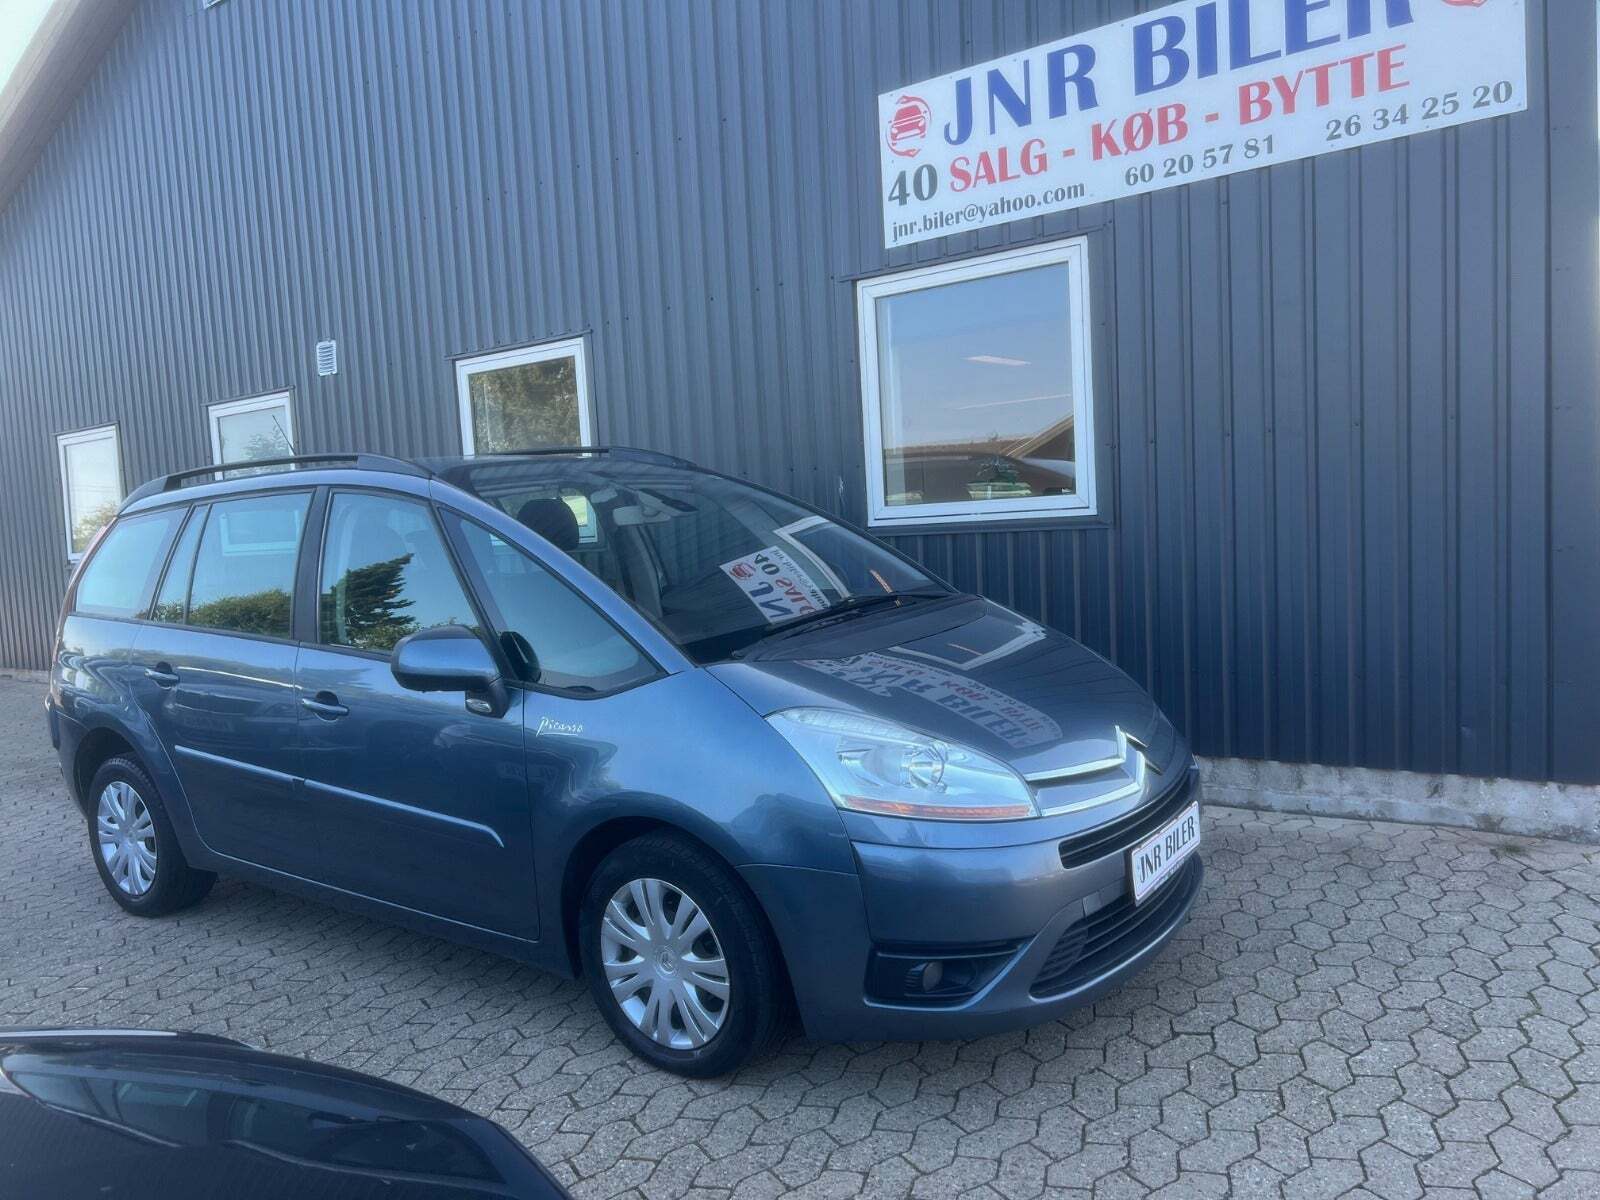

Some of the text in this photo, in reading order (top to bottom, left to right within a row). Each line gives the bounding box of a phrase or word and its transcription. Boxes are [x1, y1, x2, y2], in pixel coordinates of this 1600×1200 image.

[944, 43, 1099, 146] JNR
[950, 138, 1048, 192] SALG
[1091, 103, 1189, 162] KØB
[1238, 44, 1410, 125] BYTTE
[1326, 80, 1513, 141] 26 34 25 20
[888, 163, 938, 207] 40
[1125, 134, 1274, 187] 60 20 57 81
[892, 182, 1086, 242] jnr.biler@yahoo.com
[1139, 844, 1162, 883] JNR
[1165, 815, 1195, 861] BILER
